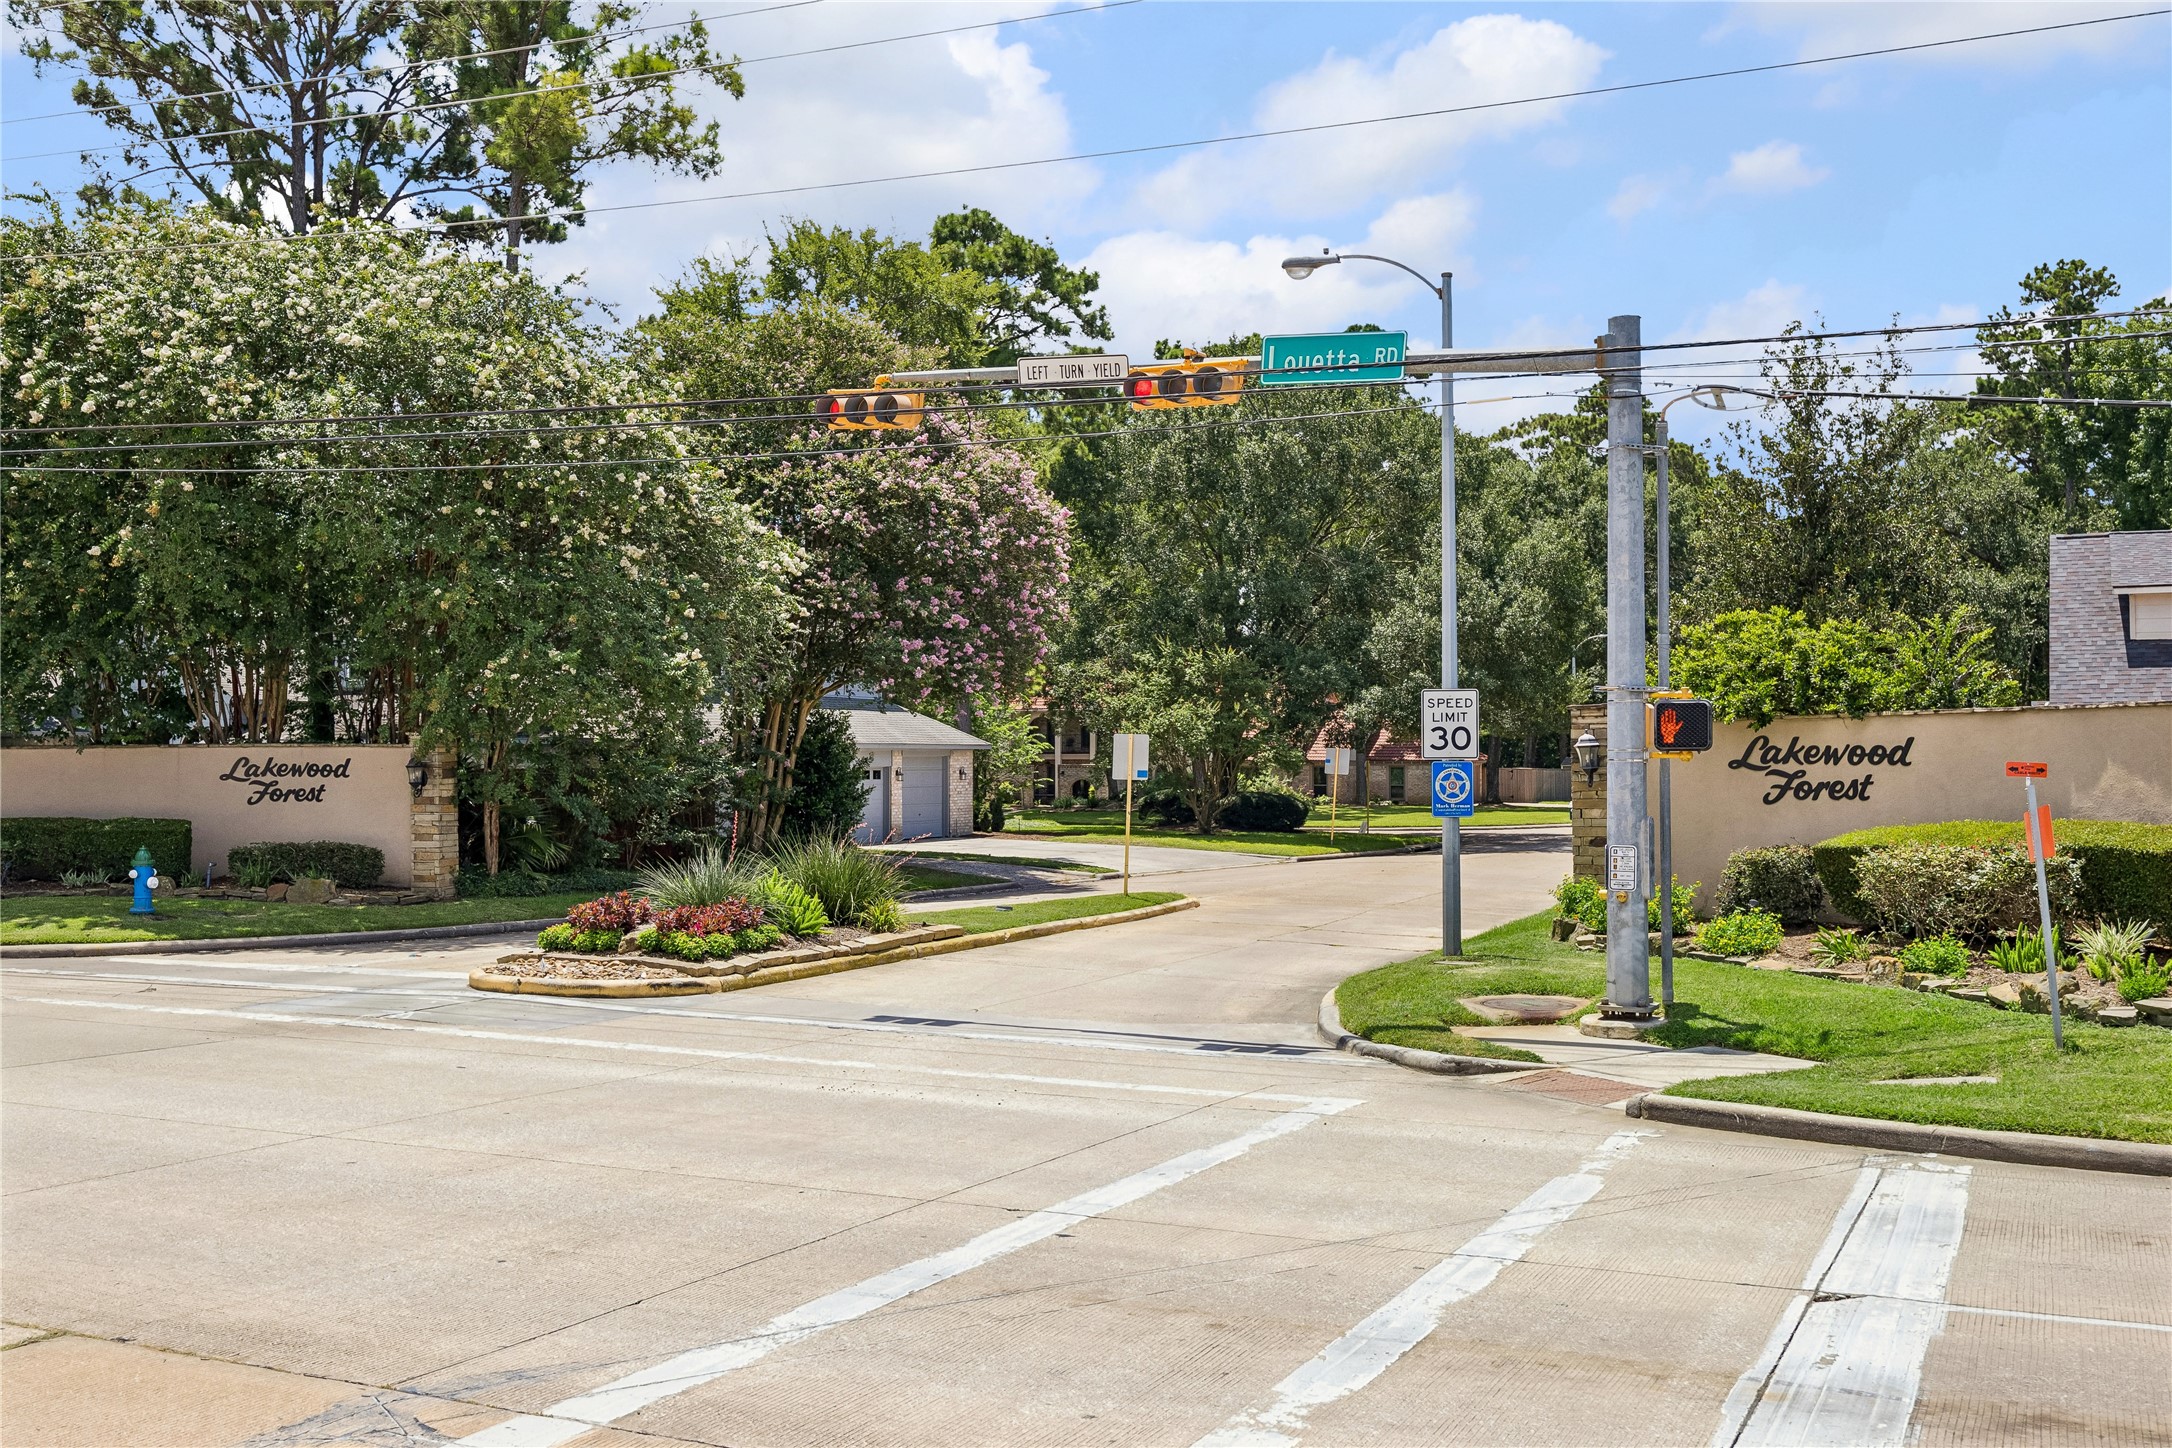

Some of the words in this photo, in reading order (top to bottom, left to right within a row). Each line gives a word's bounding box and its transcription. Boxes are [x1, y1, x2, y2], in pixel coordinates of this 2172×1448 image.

[1026, 365, 1048, 380] LEFT
[1059, 364, 1084, 379] TURN
[1093, 363, 1120, 378] YIELD
[1268, 345, 1360, 374] Louetta
[1375, 347, 1398, 364] RD
[1427, 698, 1473, 708] SPEED
[1432, 712, 1468, 722] LIMIT
[1430, 726, 1471, 750] 30
[1728, 735, 1915, 771] Lakewood
[219, 756, 351, 782] Lakewood
[247, 780, 326, 805] Forest
[1762, 769, 1874, 805] Forest
